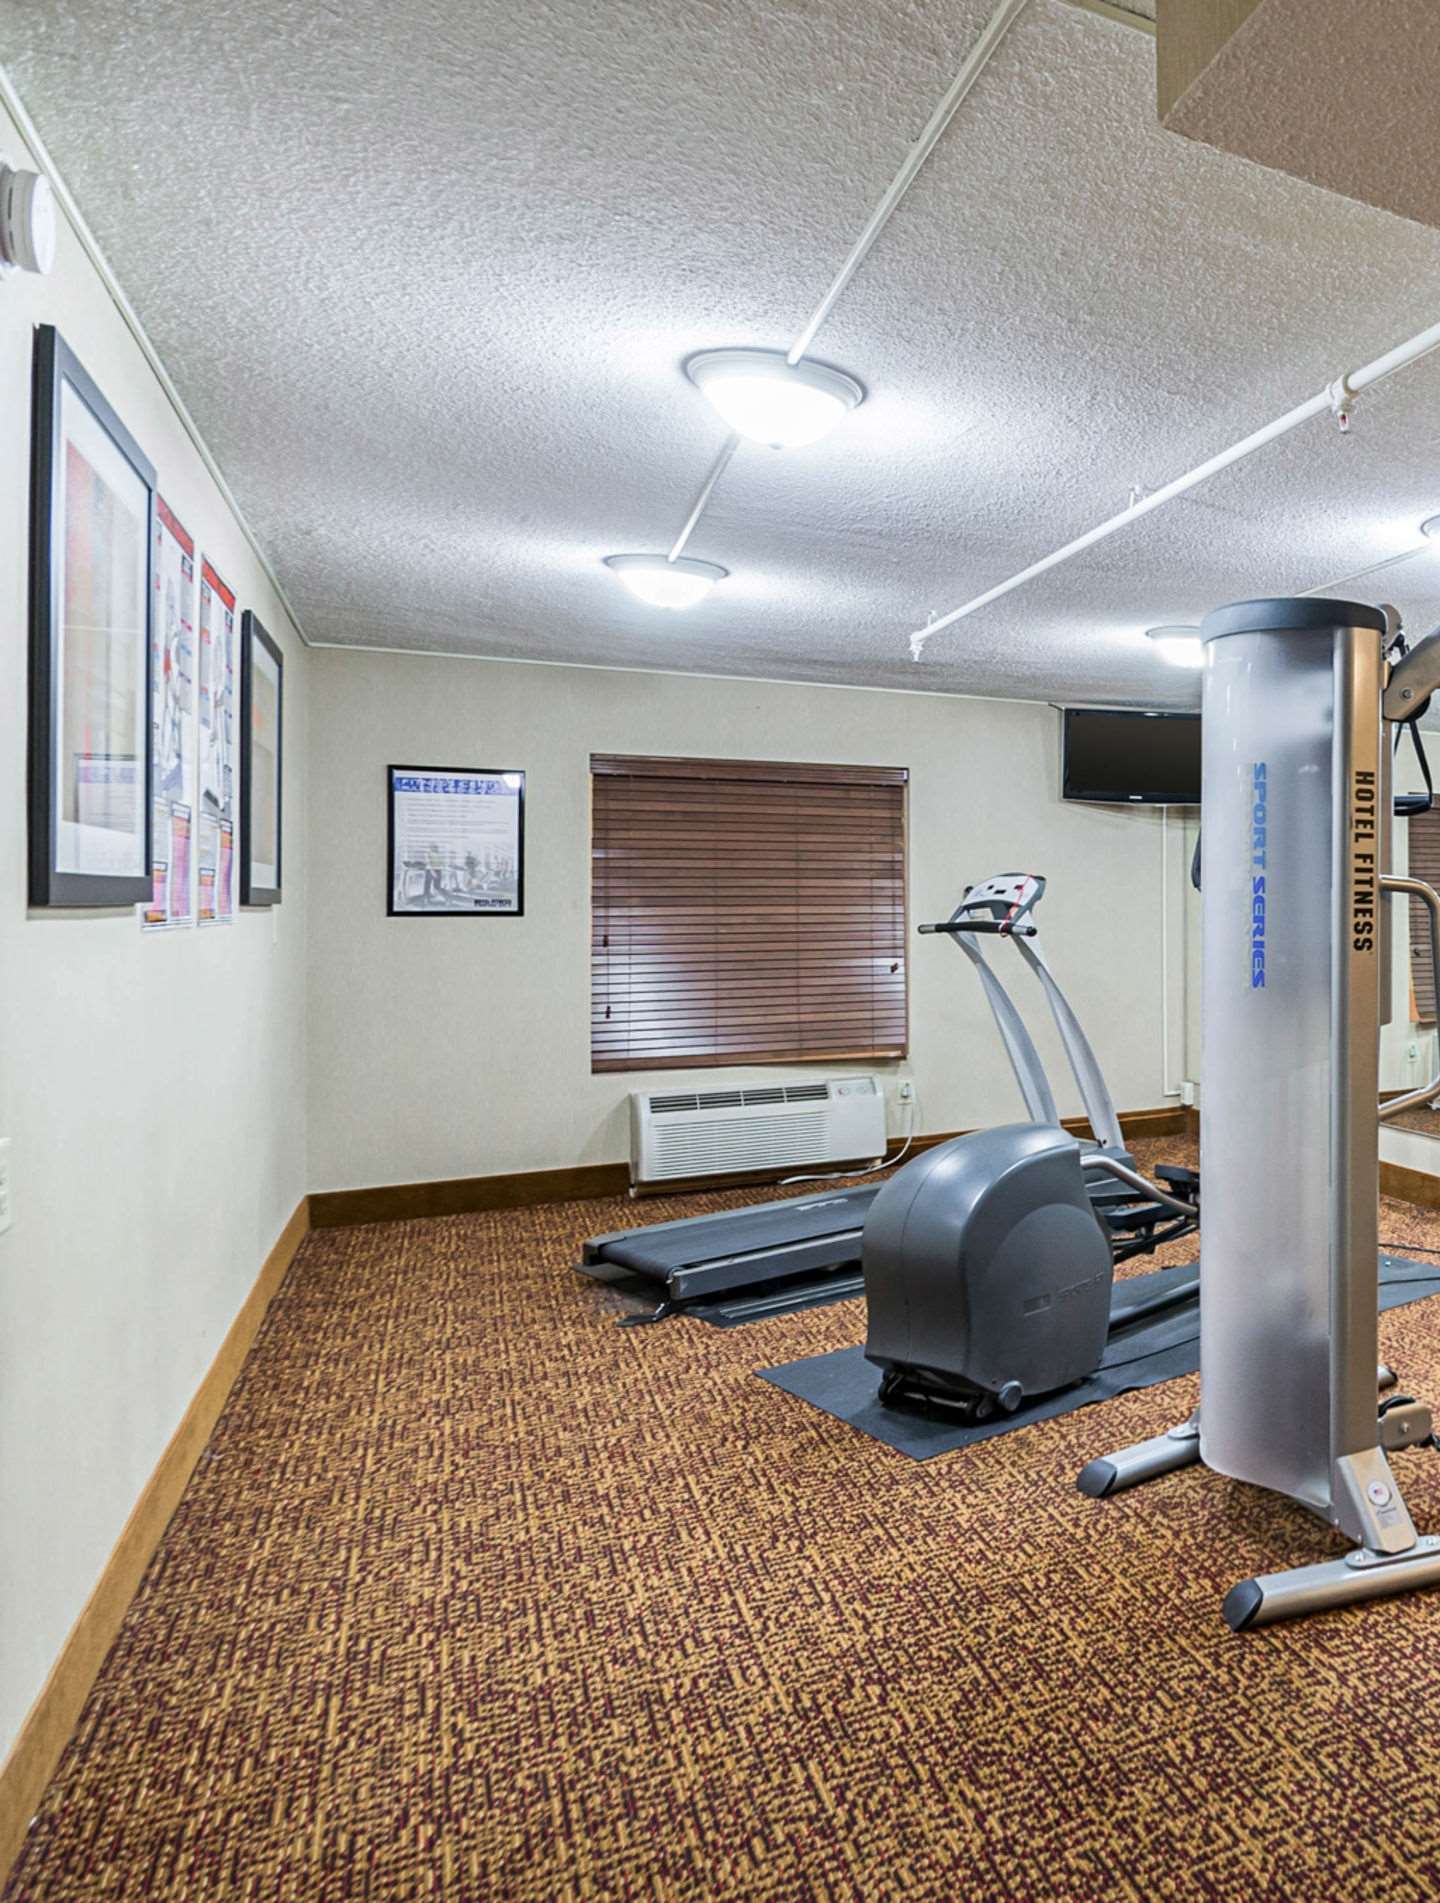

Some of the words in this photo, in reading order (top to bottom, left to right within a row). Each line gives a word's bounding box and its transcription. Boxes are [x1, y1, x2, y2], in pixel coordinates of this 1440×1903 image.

[1253, 762, 1267, 869] SPORT
[1354, 771, 1375, 843] HOTEL
[1252, 876, 1266, 989] SERIES
[1353, 853, 1374, 952] FITNESS
